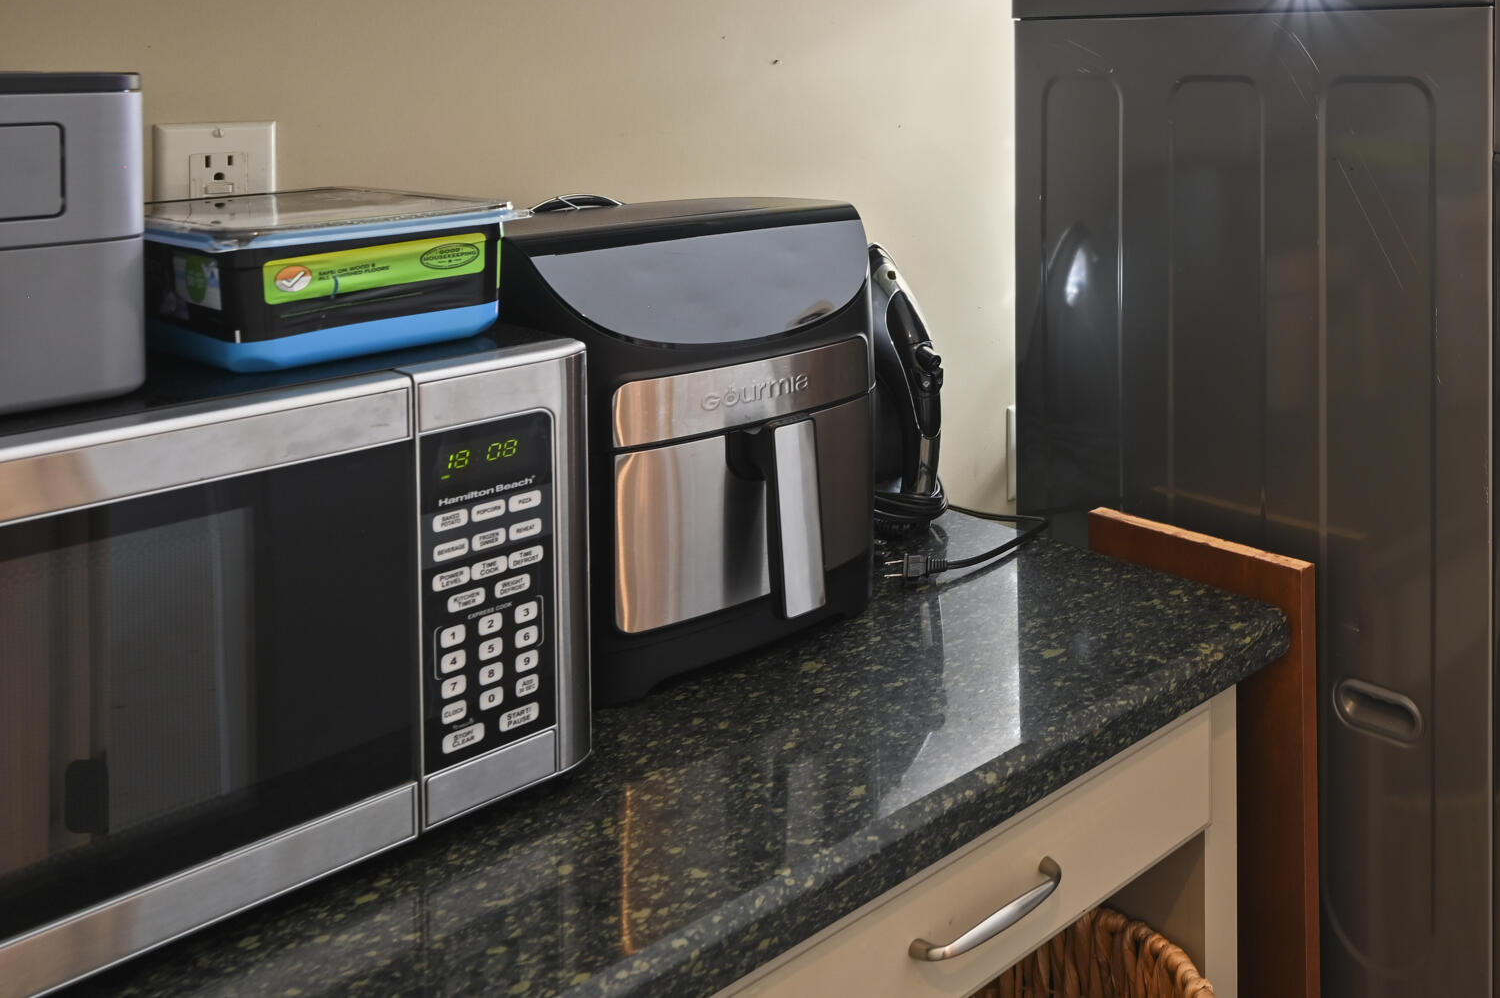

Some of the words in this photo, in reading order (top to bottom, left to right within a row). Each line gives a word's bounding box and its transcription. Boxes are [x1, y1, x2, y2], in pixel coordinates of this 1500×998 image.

[424, 250, 476, 262] HOUSEKEEPING
[438, 488, 494, 507] Hamilton
[518, 497, 532, 505] PIZZA
[476, 505, 501, 516] POPCORN
[442, 512, 460, 522] BAKED
[440, 518, 462, 528] POTATO
[516, 524, 536, 534] REHEAT
[479, 532, 500, 540] FROZEN
[480, 538, 499, 547] DINNER
[436, 544, 466, 556] BEVERAGE
[468, 606, 495, 620] EXPRESS
[495, 602, 512, 612] COOK
[523, 608, 530, 616] 3
[488, 620, 494, 628] 2
[450, 632, 456, 640] 1
[524, 632, 530, 641] 6
[488, 644, 494, 653] 5
[450, 657, 456, 666] 4
[524, 657, 530, 666] 9
[488, 669, 494, 678] 8
[451, 682, 458, 690] 7
[488, 694, 495, 703] 0
[444, 707, 464, 718] CLOCK
[508, 714, 530, 728] PAUSE
[452, 736, 475, 748] CLEAR
